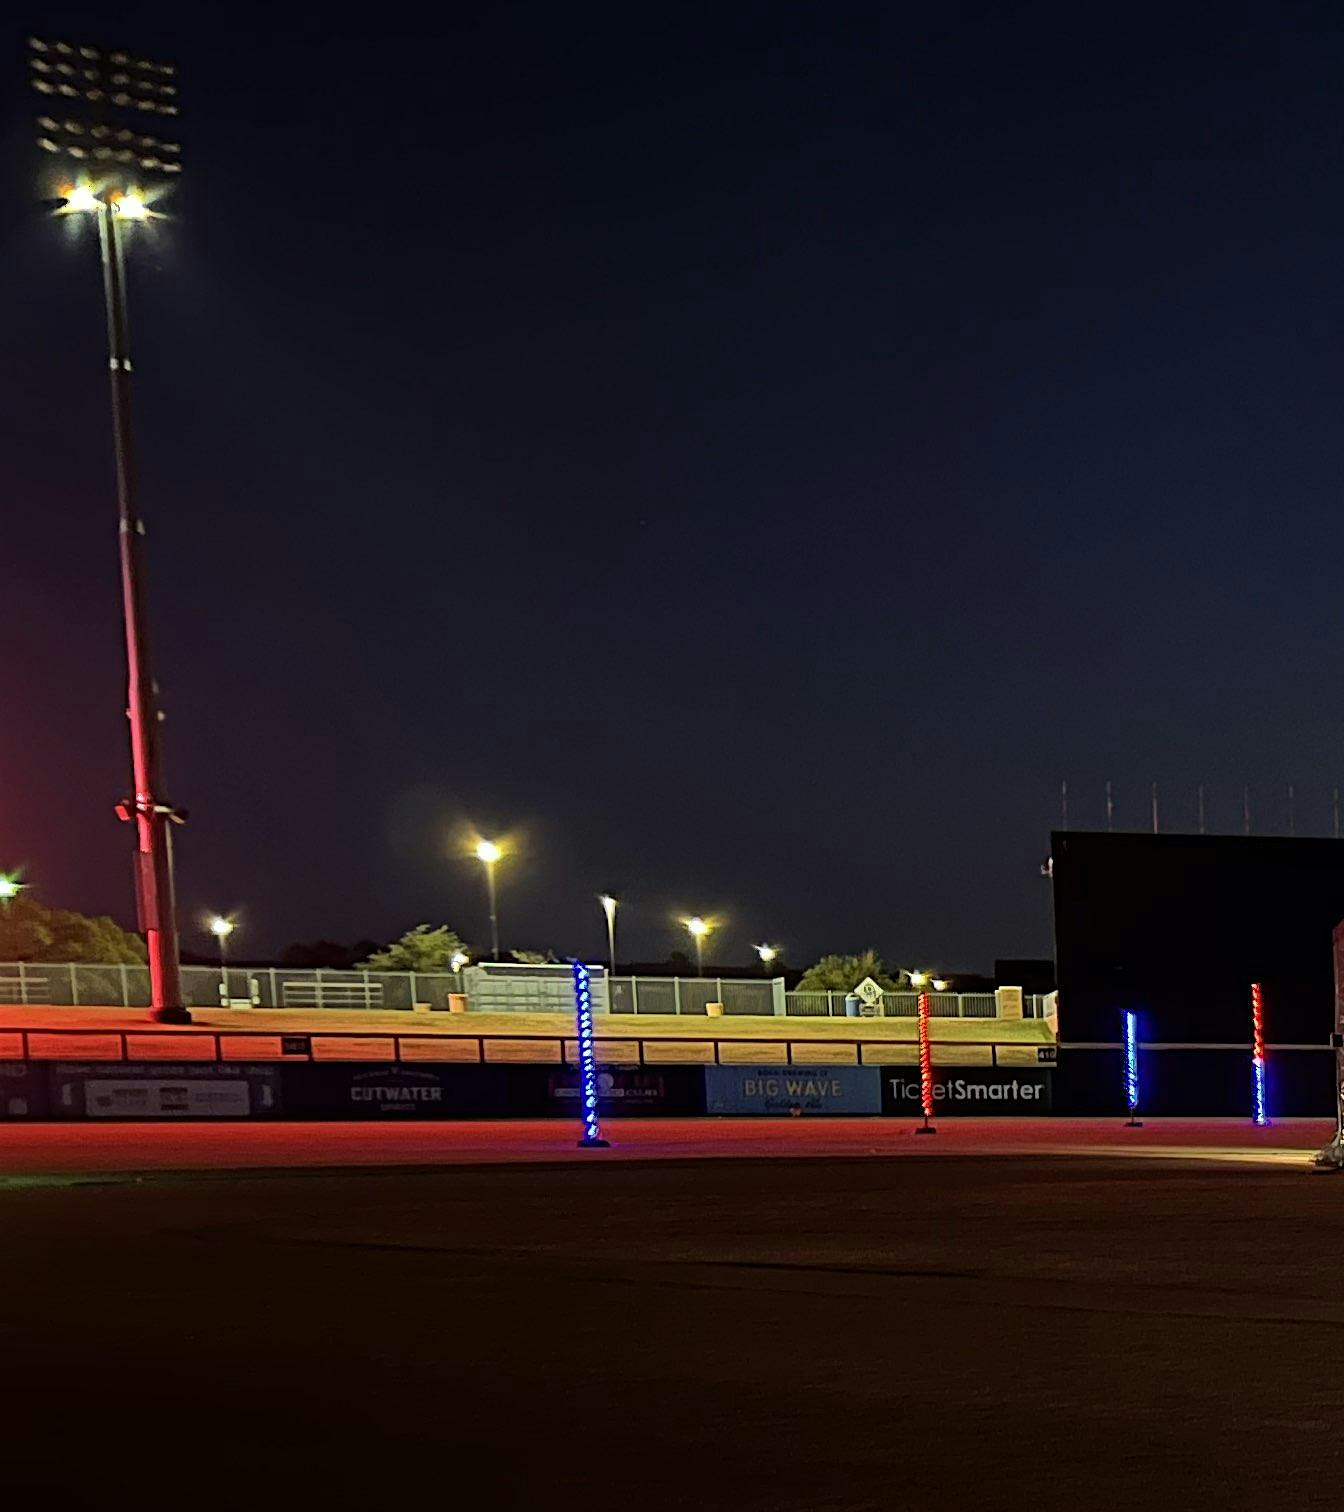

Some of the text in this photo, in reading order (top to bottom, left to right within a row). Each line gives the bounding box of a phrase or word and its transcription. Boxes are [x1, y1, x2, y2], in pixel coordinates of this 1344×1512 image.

[351, 1086, 442, 1101] CUTWATER
[744, 1080, 842, 1096] BIG WAVE
[889, 1078, 1043, 1100] TicetSmarter
